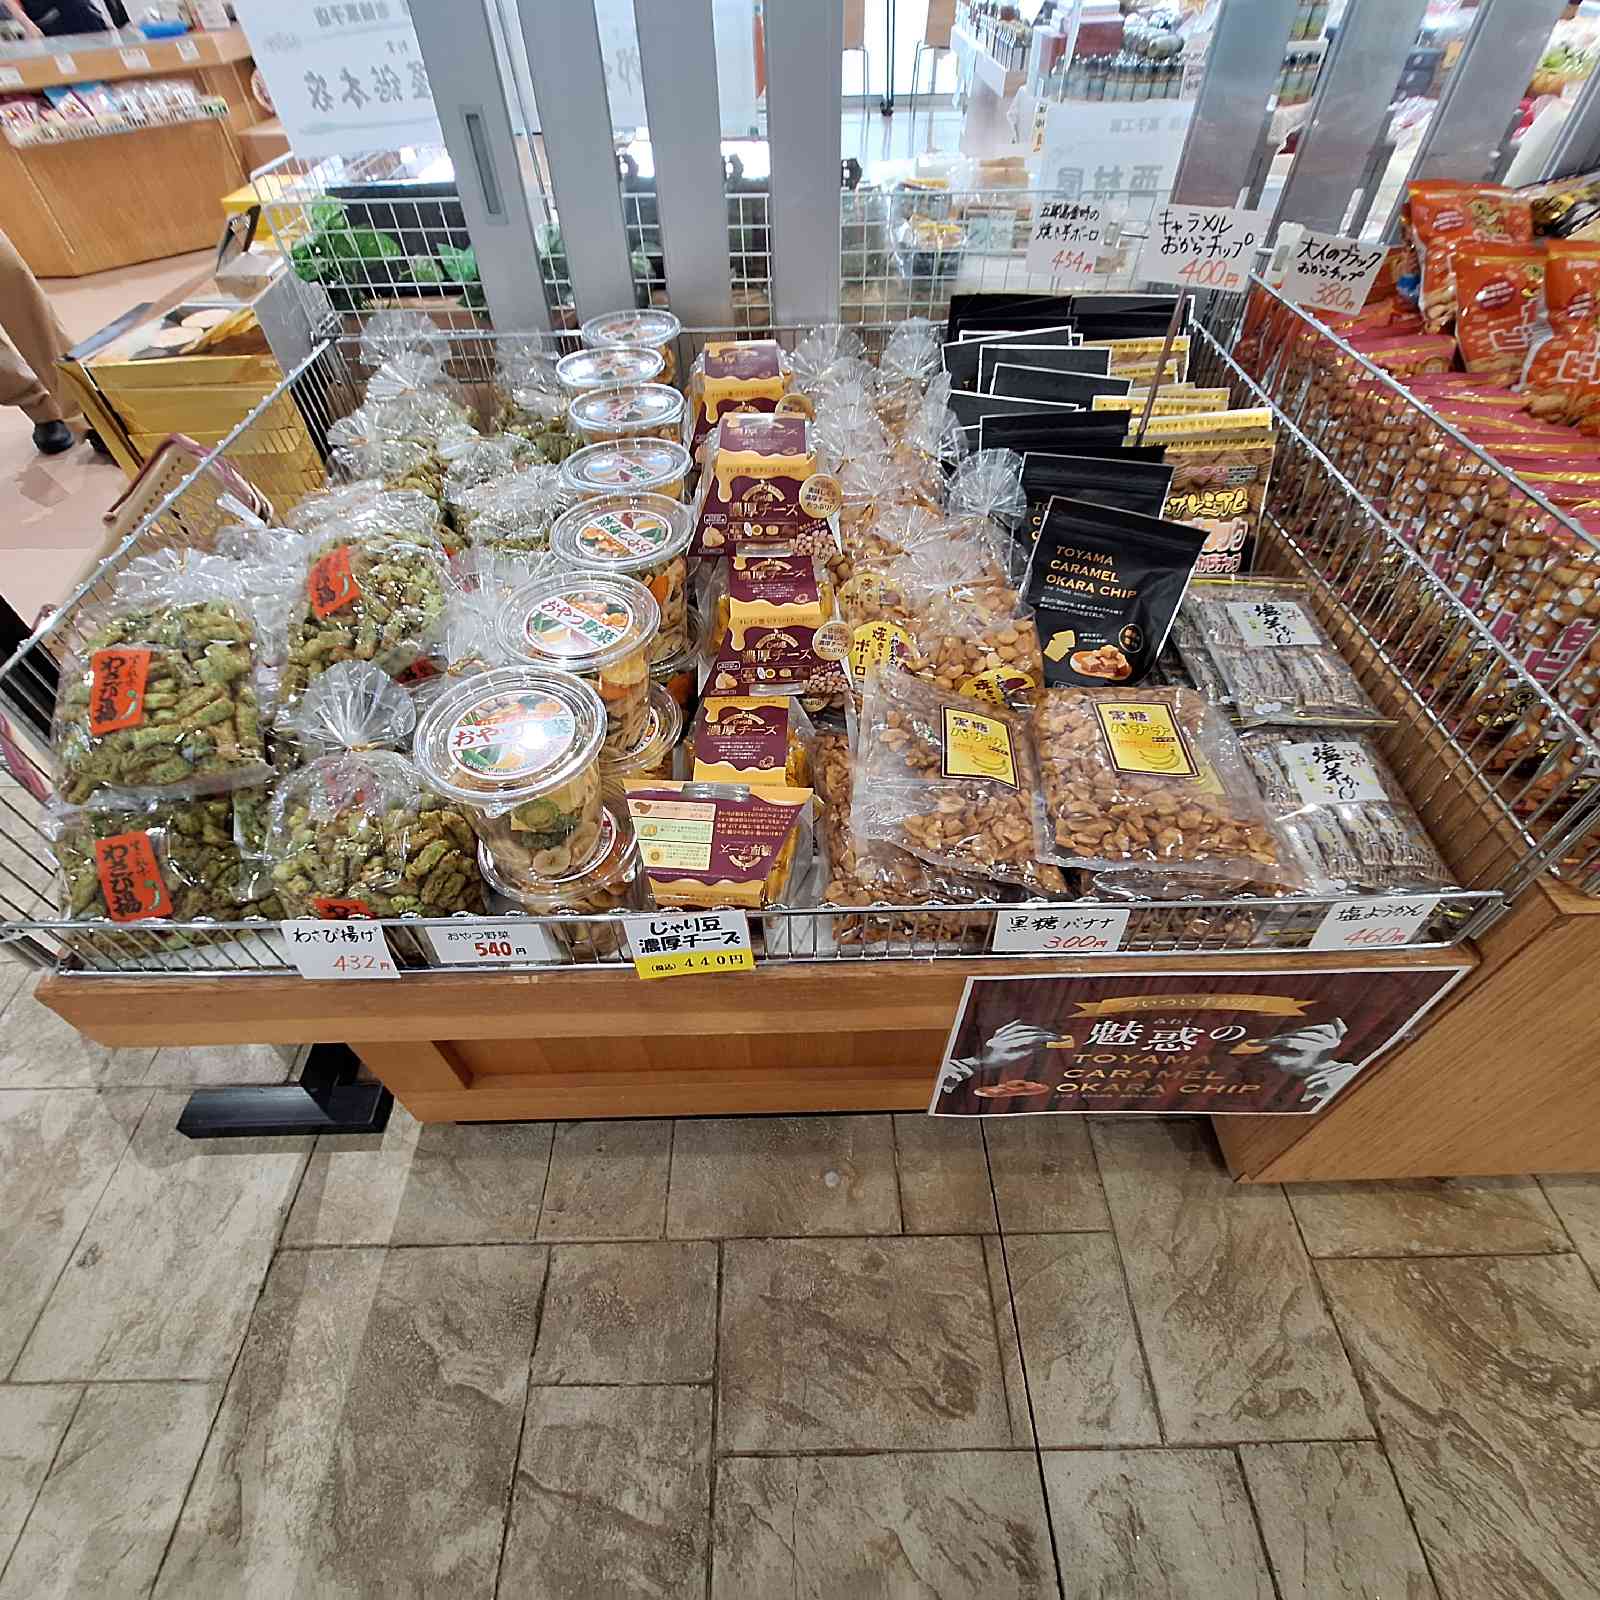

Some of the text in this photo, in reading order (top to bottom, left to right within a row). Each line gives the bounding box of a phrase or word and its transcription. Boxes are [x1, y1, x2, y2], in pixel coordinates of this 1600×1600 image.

[1158, 208, 1233, 234] キャラメル
[1160, 232, 1254, 258] おからチップ
[1297, 237, 1382, 271] 大人のブラック
[1178, 257, 1240, 287] 400円
[1297, 261, 1366, 282] おからチップ
[1056, 545, 1113, 566] TOYAMA
[1050, 559, 1120, 583] CARAMEL
[1046, 573, 1095, 594] OKARA
[1099, 585, 1137, 600] CHIP
[706, 723, 778, 736] 濃厚チーズ
[1335, 903, 1425, 922] 塩ようかん
[293, 916, 379, 943] わさび揚げ
[650, 915, 723, 936] じゃり豆
[1006, 915, 1115, 932] 黒糖 バナナ
[447, 931, 511, 942] おやつ野菜
[638, 931, 741, 954] 濃厚チーズ
[1043, 935, 1109, 949] 300円
[474, 942, 512, 957] 540
[332, 954, 391, 972] 432円
[1083, 1019, 1248, 1053] 魅惑の
[1073, 1053, 1213, 1066] TOYAMA
[1063, 1068, 1226, 1081] CARAMEL
[1055, 1082, 1262, 1095] OKARA CHIP
